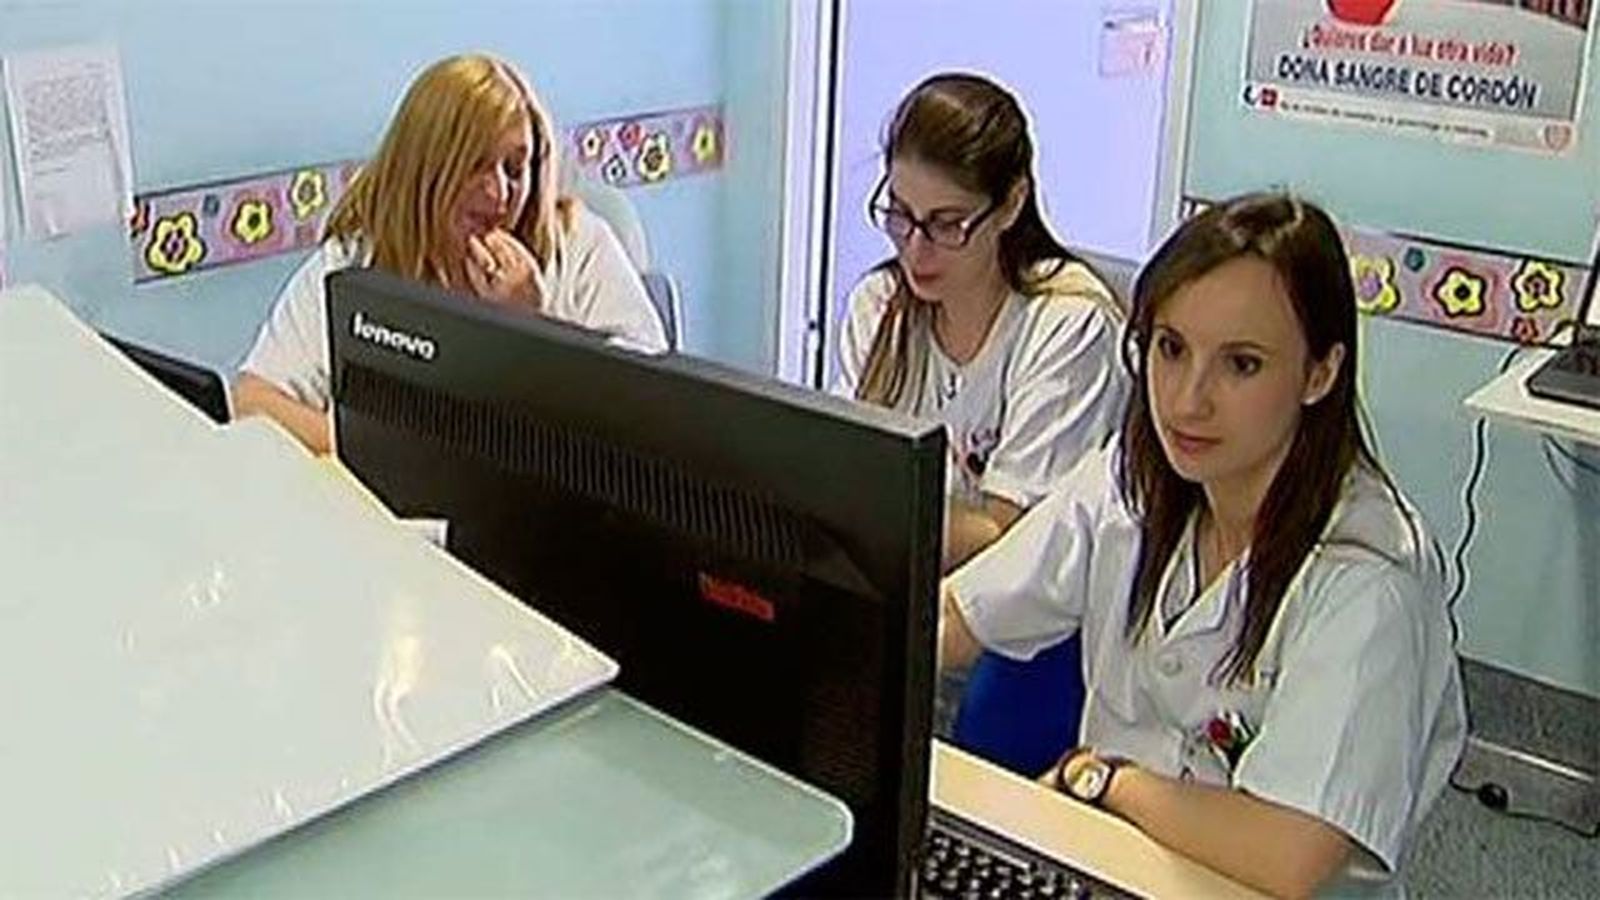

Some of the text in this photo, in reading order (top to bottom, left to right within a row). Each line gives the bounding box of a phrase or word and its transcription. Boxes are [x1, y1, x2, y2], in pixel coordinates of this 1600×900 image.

[1279, 55, 1537, 109] DONA SANGRE DE CORDÓN
[354, 312, 434, 359] lenovo
